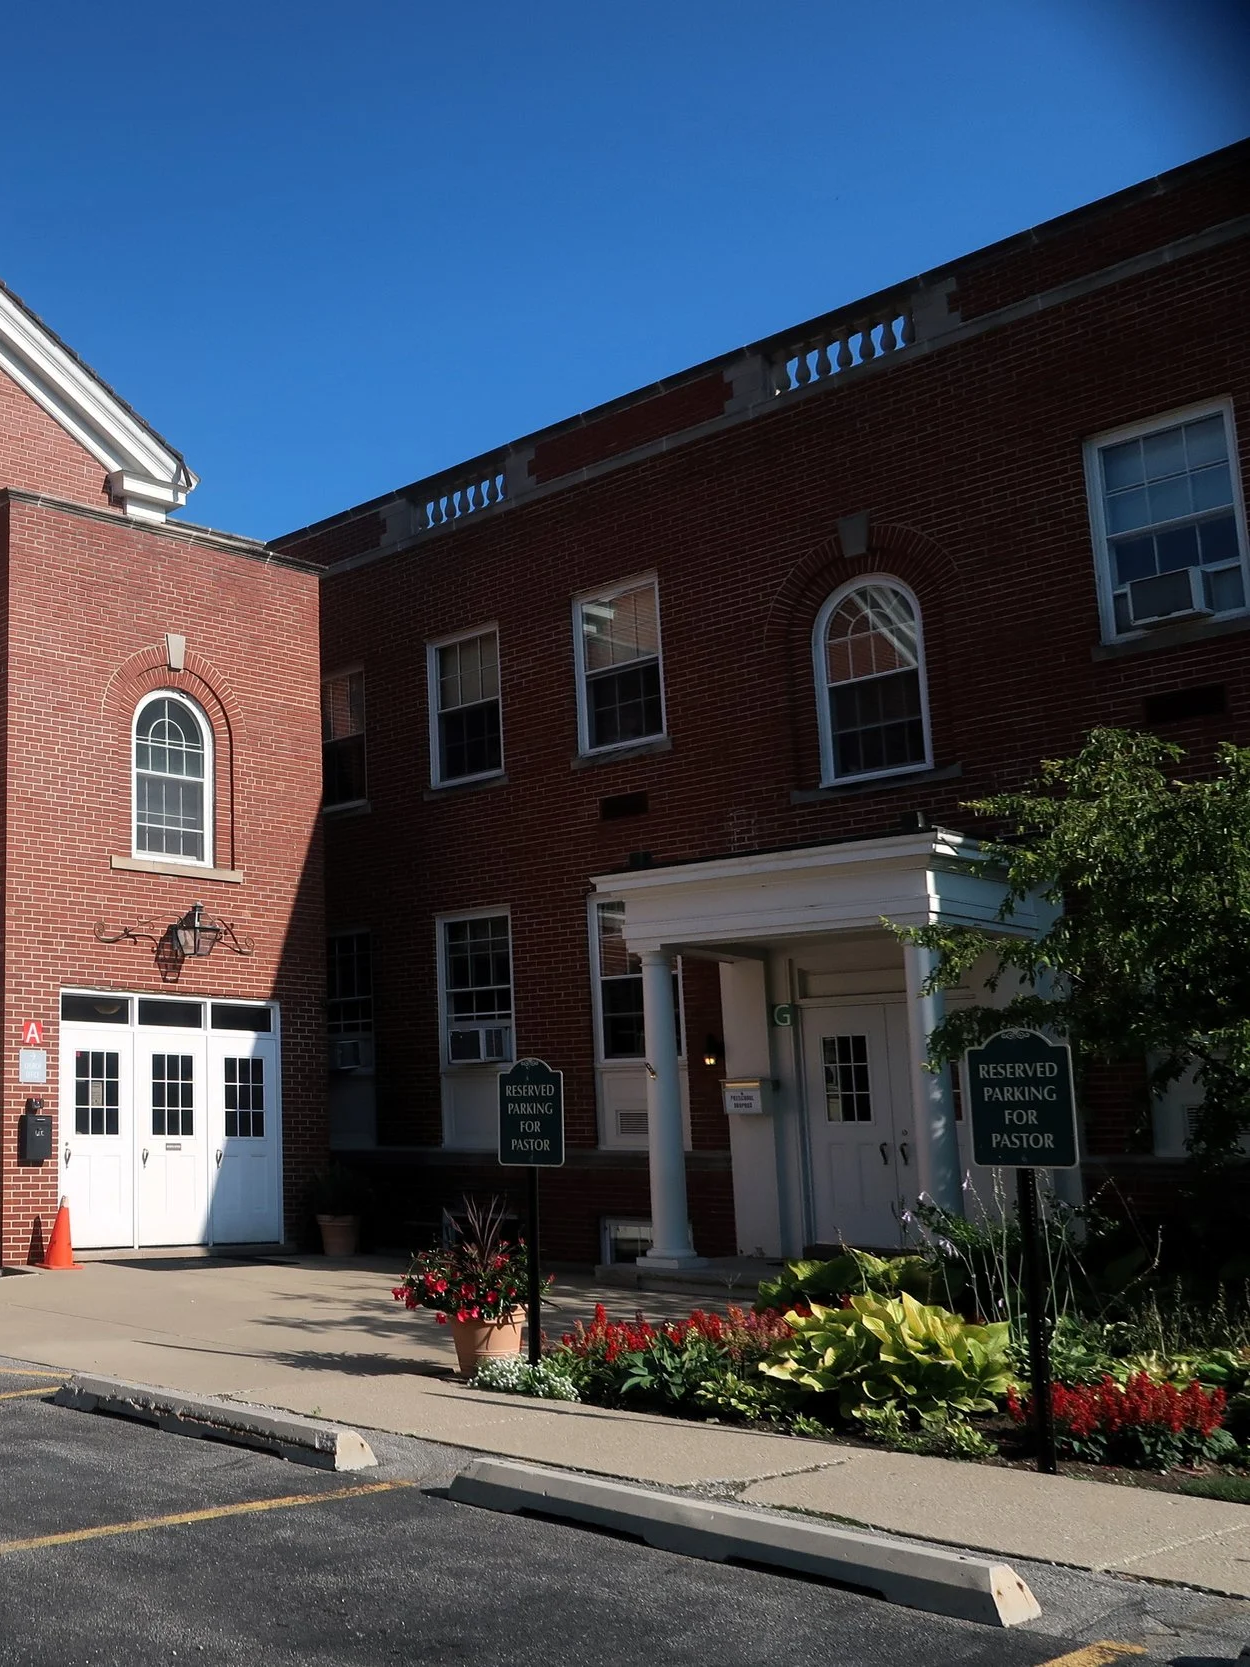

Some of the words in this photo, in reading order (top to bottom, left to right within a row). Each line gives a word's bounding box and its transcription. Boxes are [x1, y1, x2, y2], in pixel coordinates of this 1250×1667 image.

[774, 1004, 791, 1027] G
[25, 1022, 40, 1044] A
[978, 1062, 1058, 1079] RESERVED
[505, 1084, 555, 1097] RESERVED
[983, 1086, 1057, 1102] PARKING
[508, 1102, 553, 1115] PARKING
[1004, 1109, 1039, 1125] FOR
[520, 1120, 541, 1133] FOR
[511, 1138, 551, 1151] PASTOR
[991, 1133, 1055, 1149] PASTOR
